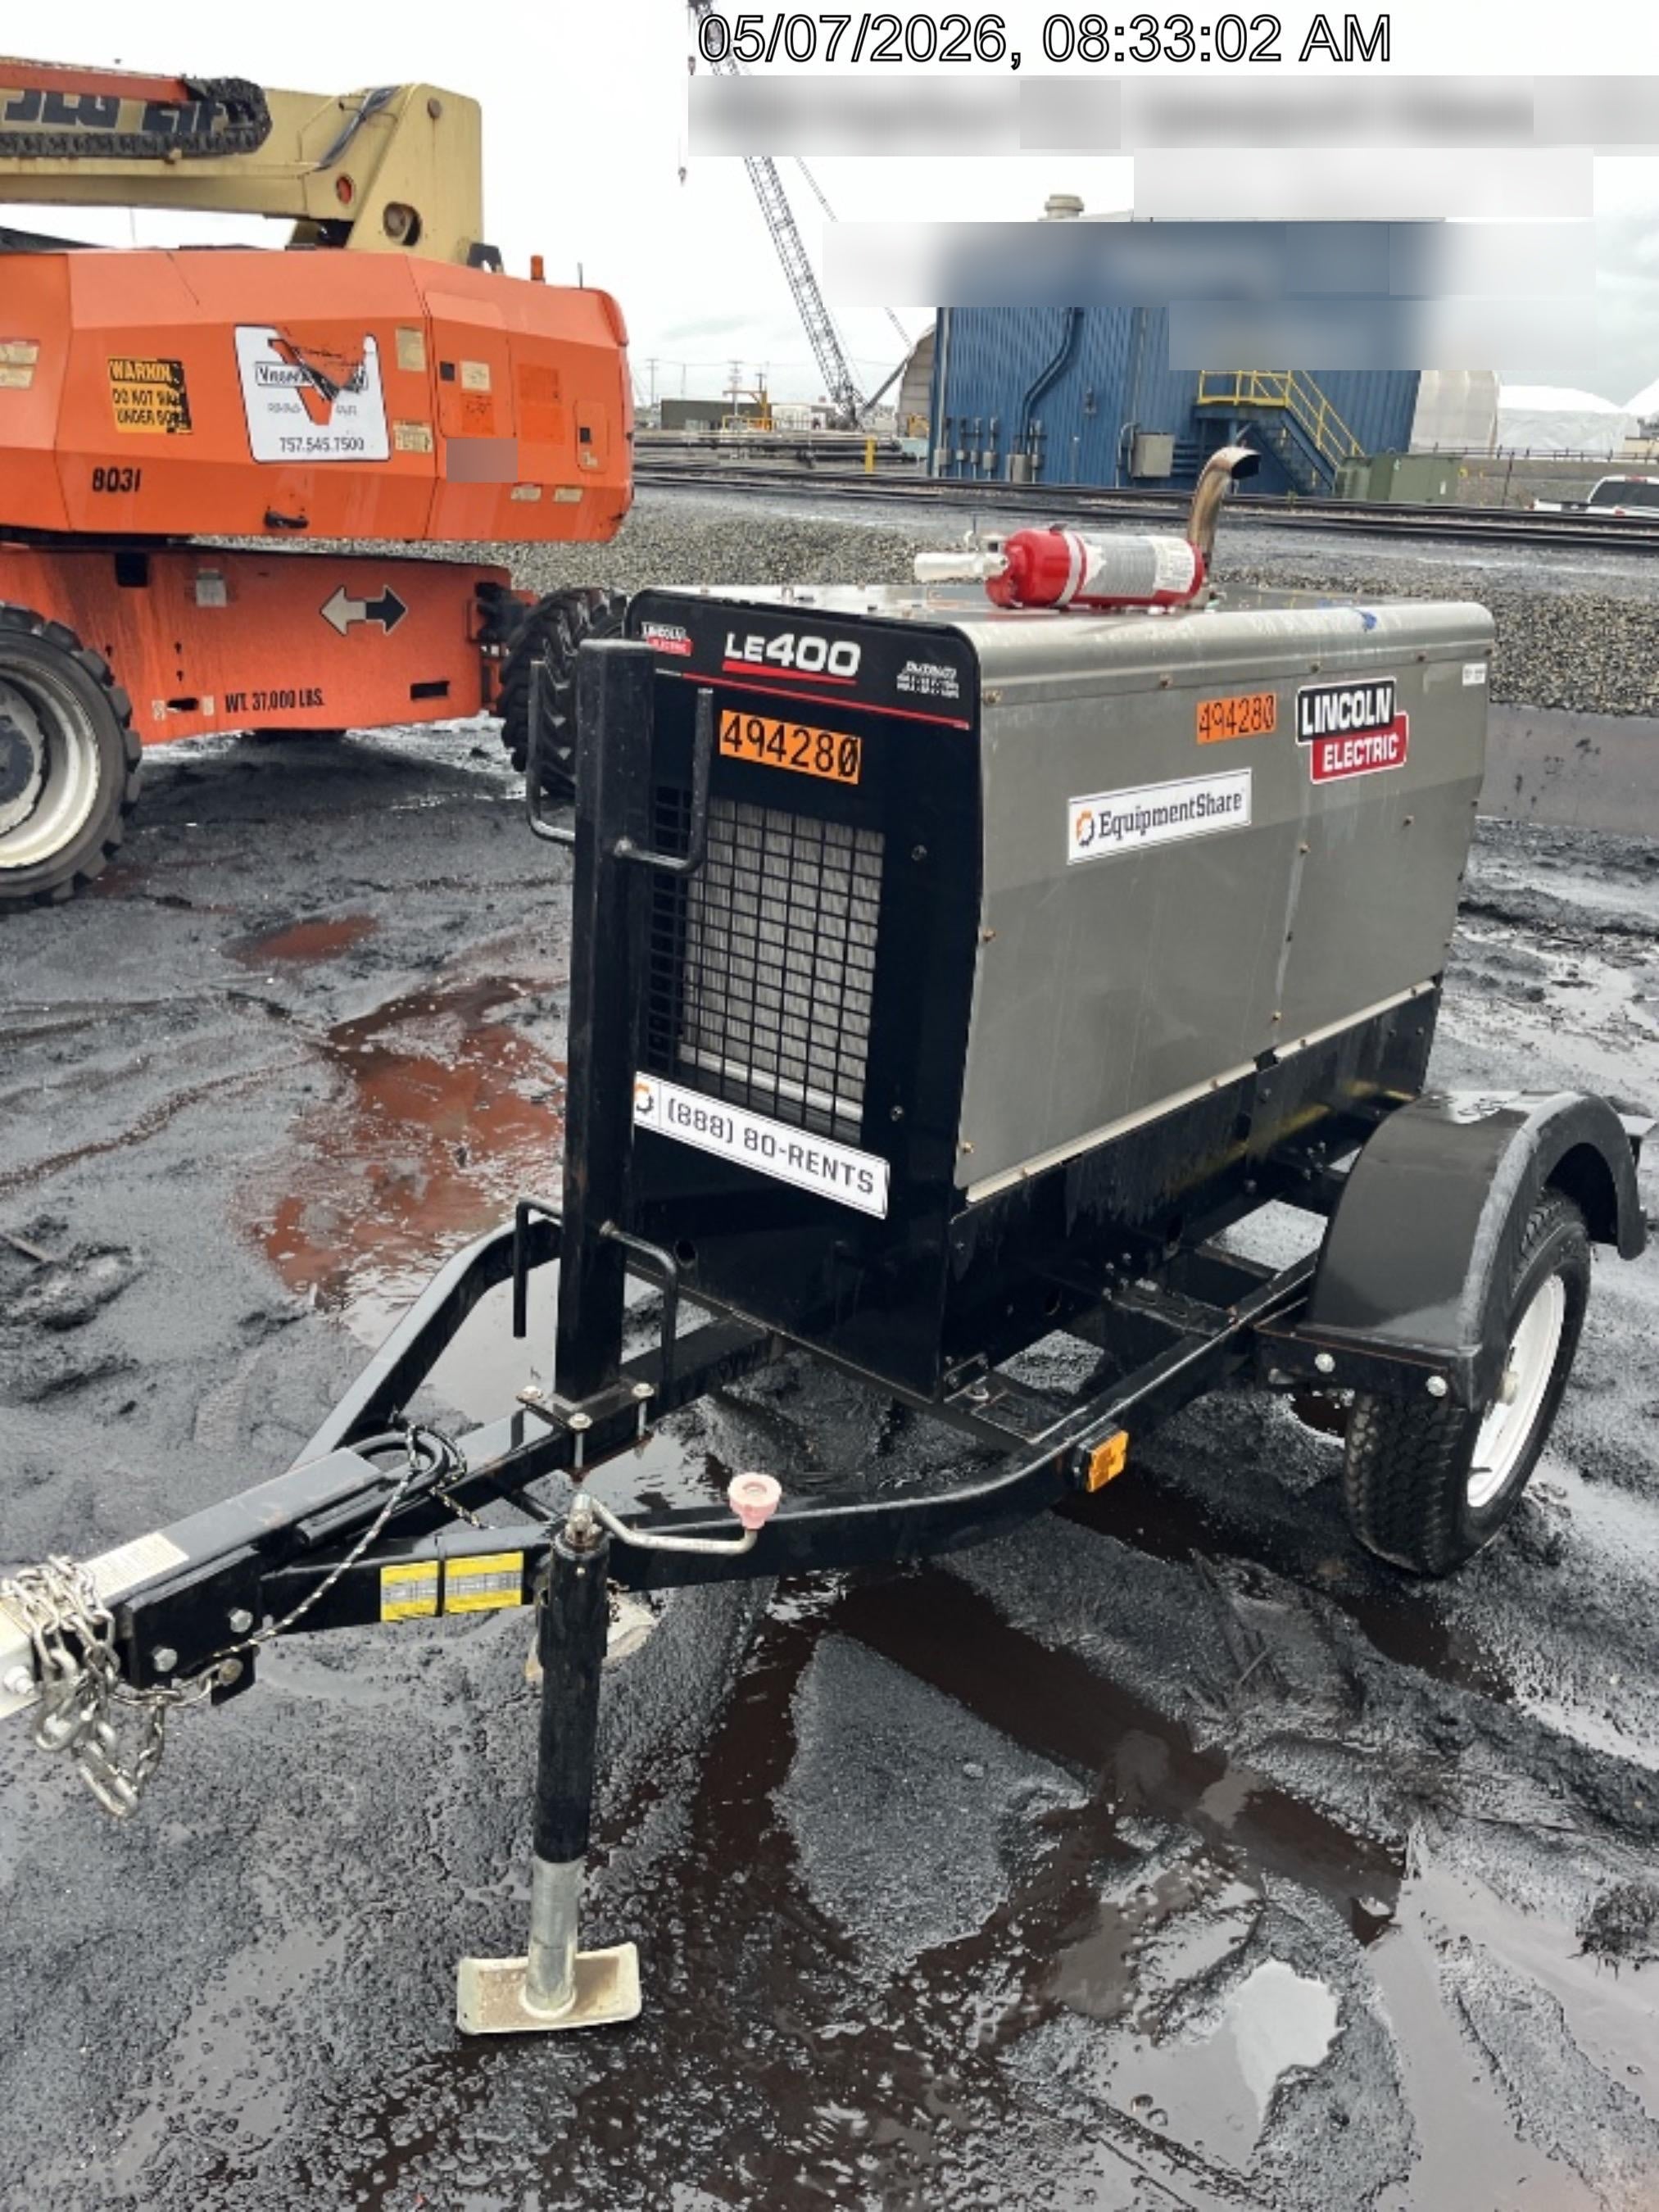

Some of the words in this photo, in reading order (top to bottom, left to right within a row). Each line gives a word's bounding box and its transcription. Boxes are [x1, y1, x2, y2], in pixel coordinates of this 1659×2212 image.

[724, 631, 861, 678] LE400
[1199, 694, 1275, 739] 494280
[1302, 687, 1392, 736] LINCOLN
[723, 714, 859, 778] 494280
[1321, 732, 1399, 773] ELECTRIC
[1098, 790, 1243, 840] EquipmentShare
[667, 1098, 734, 1144] (888)
[743, 1127, 874, 1194] 80-RENTS
